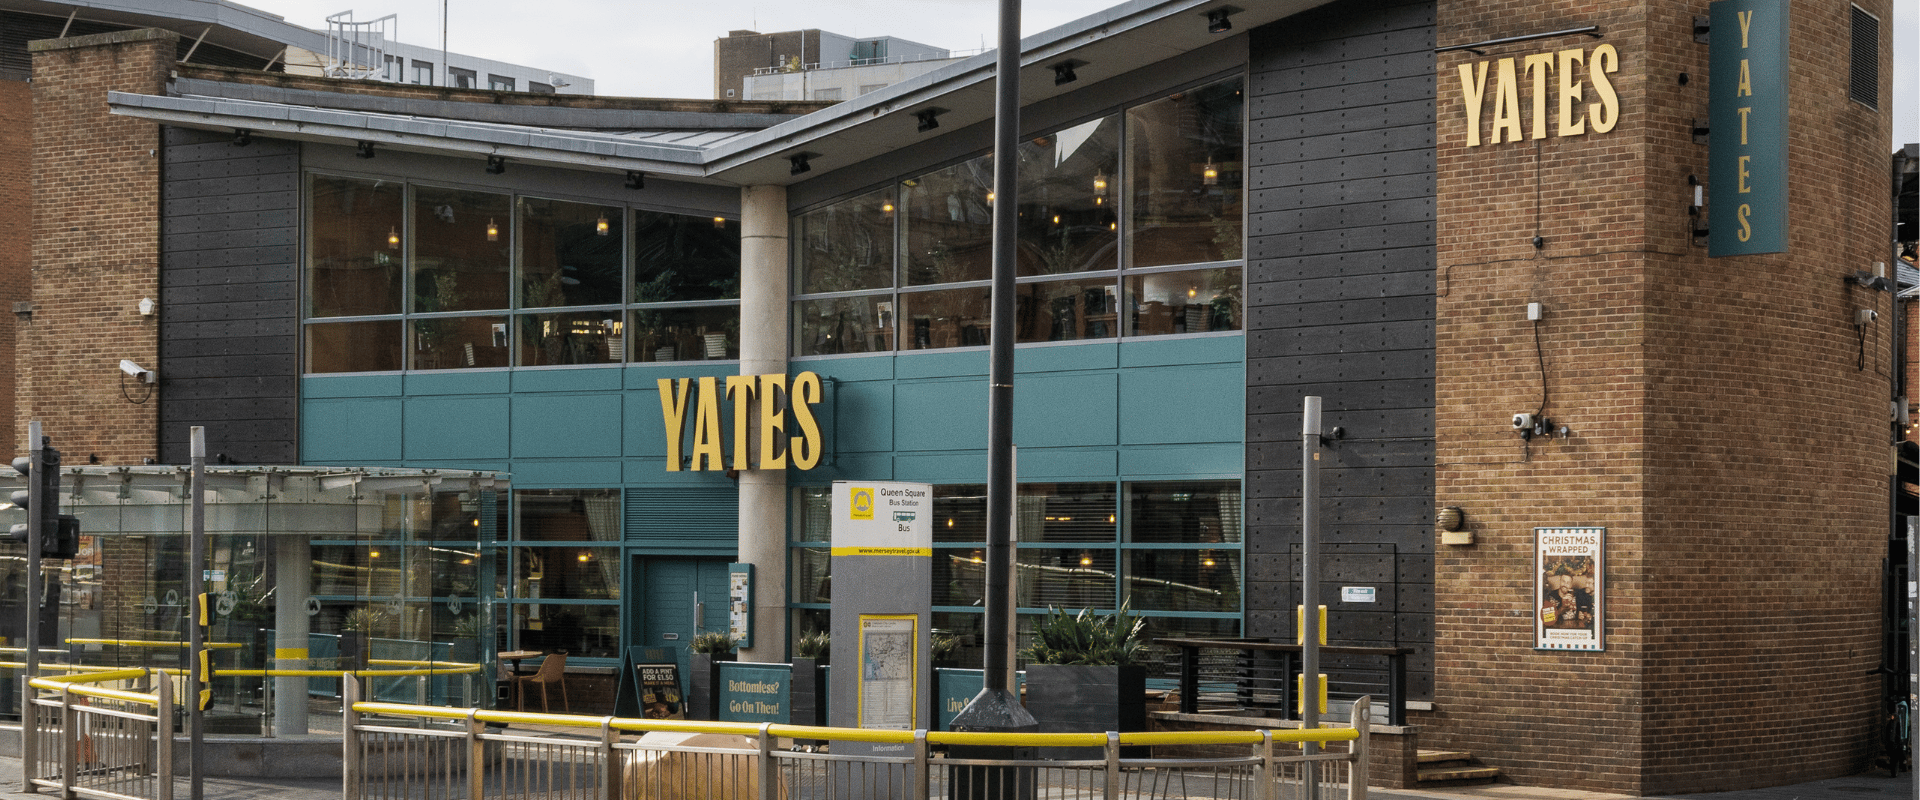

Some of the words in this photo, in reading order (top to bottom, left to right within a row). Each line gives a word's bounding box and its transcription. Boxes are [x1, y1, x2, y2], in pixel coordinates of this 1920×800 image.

[1457, 43, 1619, 147] YATES
[1736, 10, 1752, 243] YATES
[657, 371, 824, 471] YATES
[880, 488, 904, 497] Queen
[904, 488, 926, 498] Square
[898, 523, 911, 532] Bus
[1542, 536, 1598, 546] CHRISTMAS,
[1549, 545, 1588, 554] WRAPPED
[728, 679, 780, 695] Bottomless?
[729, 700, 741, 713] Go
[742, 700, 754, 713] On
[755, 700, 779, 714] Then!
[947, 697, 963, 712] Live
[872, 744, 905, 752] Information
